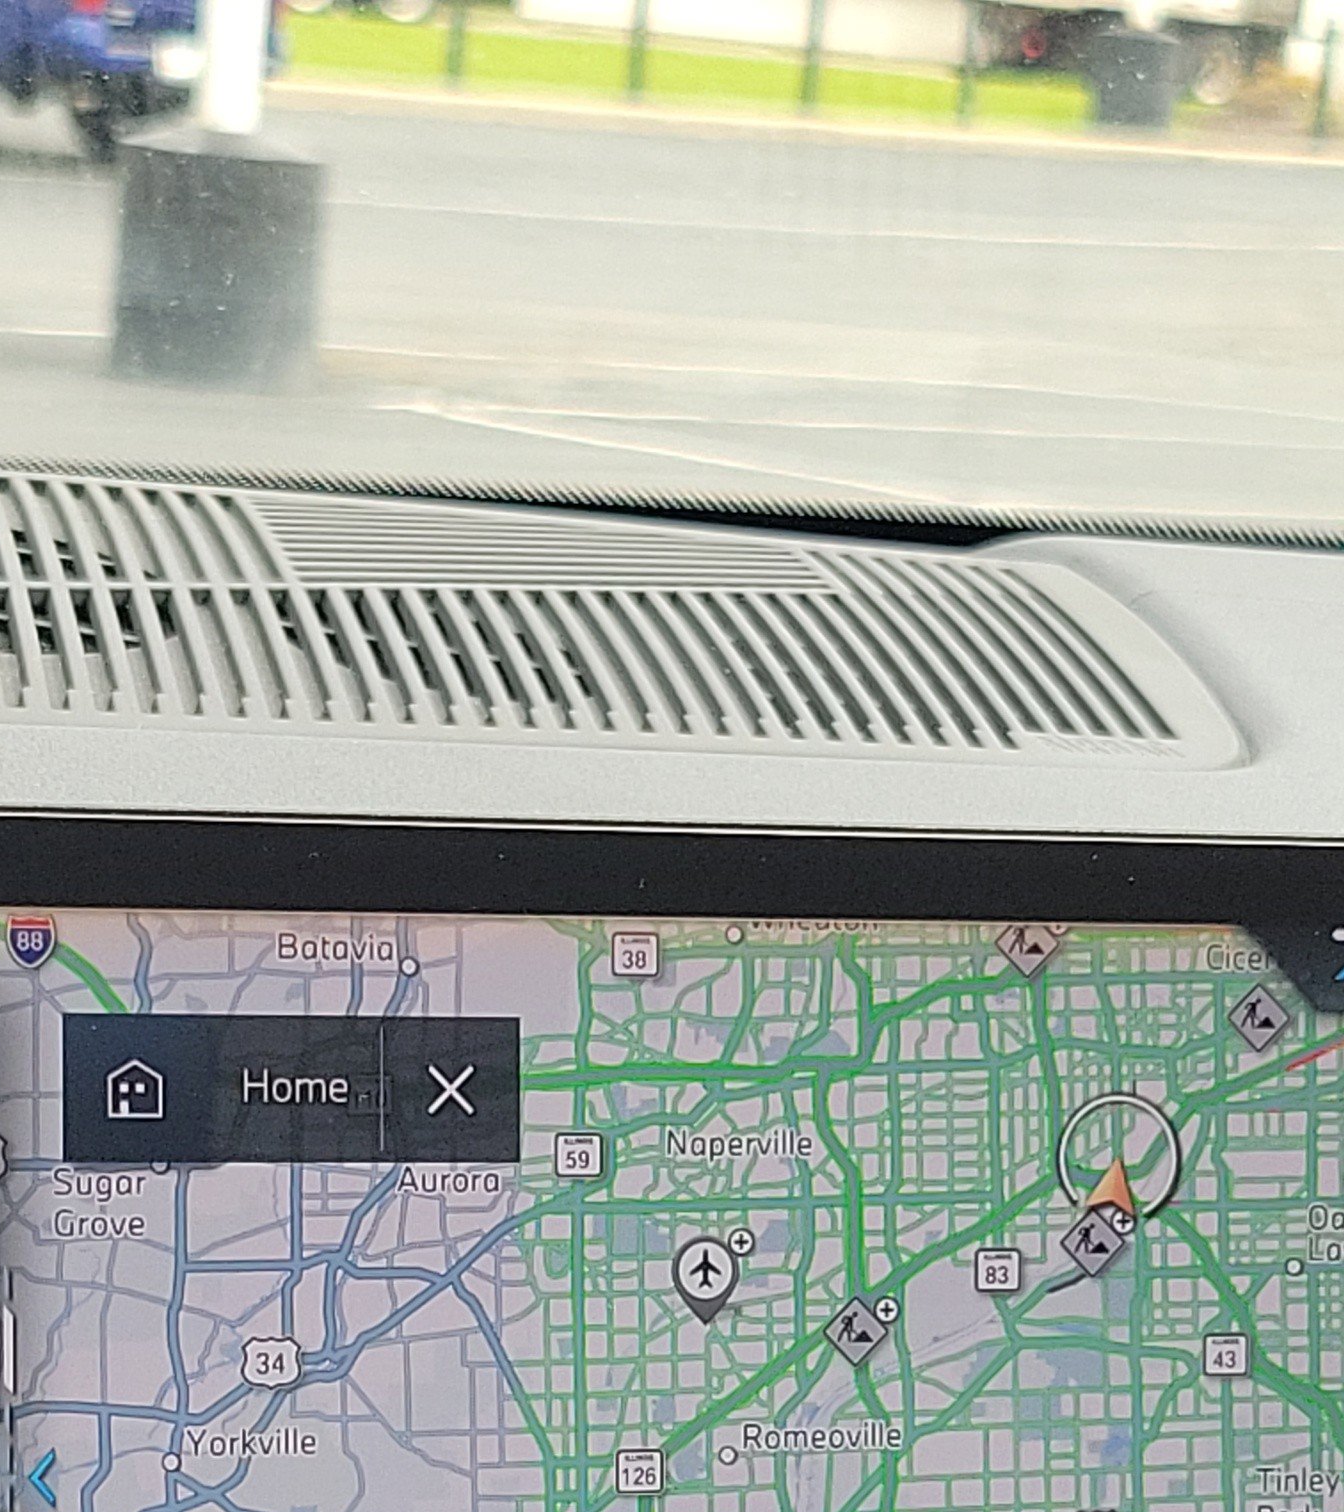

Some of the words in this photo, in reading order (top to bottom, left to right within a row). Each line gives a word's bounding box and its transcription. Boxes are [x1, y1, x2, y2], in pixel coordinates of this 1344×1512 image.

[16, 930, 44, 951] 88
[278, 933, 394, 961] Batavia
[622, 950, 646, 969] 38
[242, 1068, 349, 1104] Home
[565, 1150, 590, 1169] 59
[666, 1130, 813, 1165] Naperville
[53, 1167, 146, 1202] Sugar
[397, 1167, 500, 1193] Aurora
[56, 1209, 145, 1237] Grove
[986, 1265, 1009, 1284] 83
[256, 1352, 285, 1375] 34
[1213, 1350, 1236, 1369] 43
[188, 1430, 316, 1458] Yorkville
[742, 1424, 902, 1451] Romeoville
[622, 1467, 656, 1486] 126
[1257, 1468, 1340, 1497] Tinley
